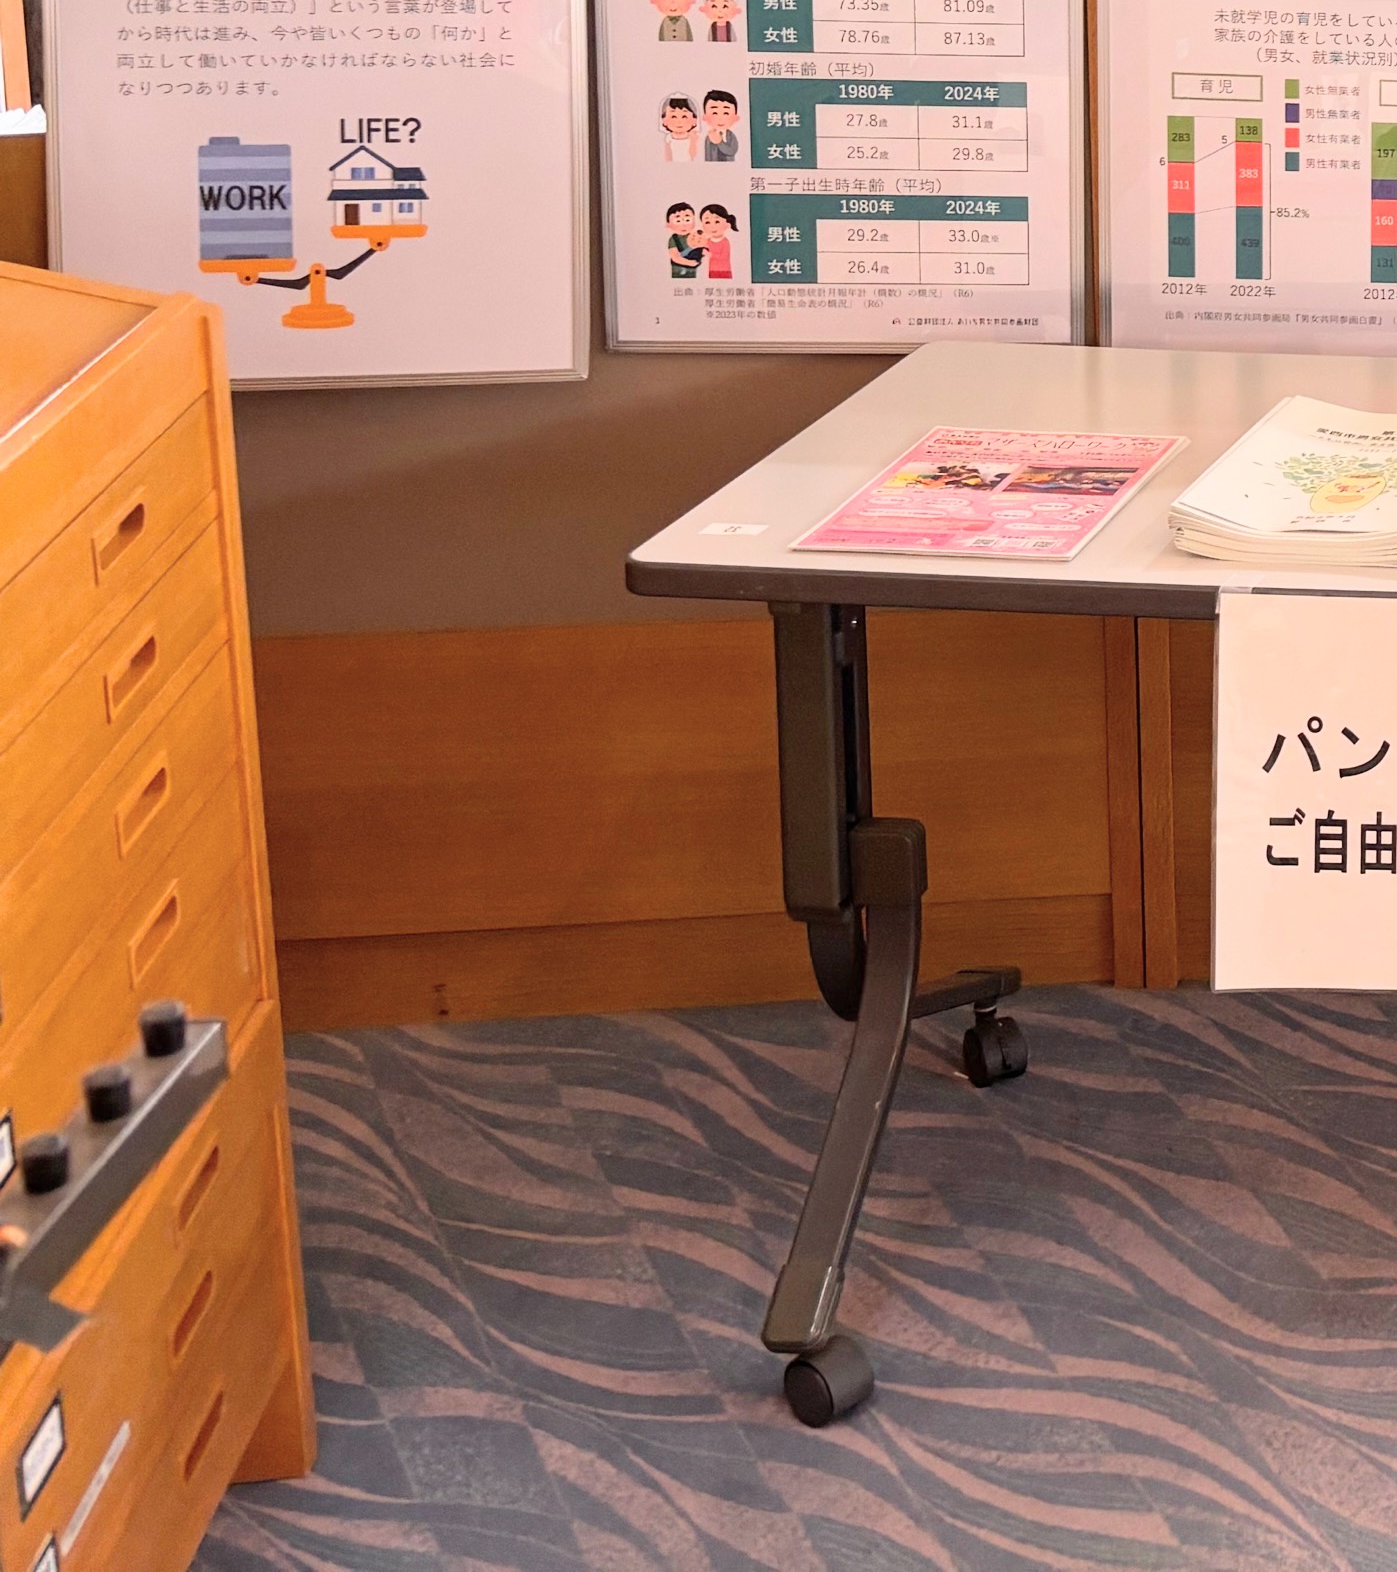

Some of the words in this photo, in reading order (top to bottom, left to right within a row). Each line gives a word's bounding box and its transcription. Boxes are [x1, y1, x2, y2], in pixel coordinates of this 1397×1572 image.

[764, 26, 798, 43] 女性
[838, 29, 890, 45] 78.76歳
[943, 31, 995, 48] 87.13歳
[117, 51, 516, 70] 両立して働いていかなければならない社会に
[118, 79, 282, 97] なりつつあります。
[1200, 78, 1234, 95] 育児
[341, 117, 421, 145] LIFE?
[1305, 132, 1361, 145] 女性有業者
[1377, 149, 1395, 158] 197
[1305, 157, 1361, 170] 男性有業者
[200, 185, 288, 213] WORK
[1277, 207, 1310, 219] 85.2%
[1375, 216, 1393, 226] 160
[1162, 283, 1207, 296] 2012年
[1230, 285, 1276, 297] 2022年
